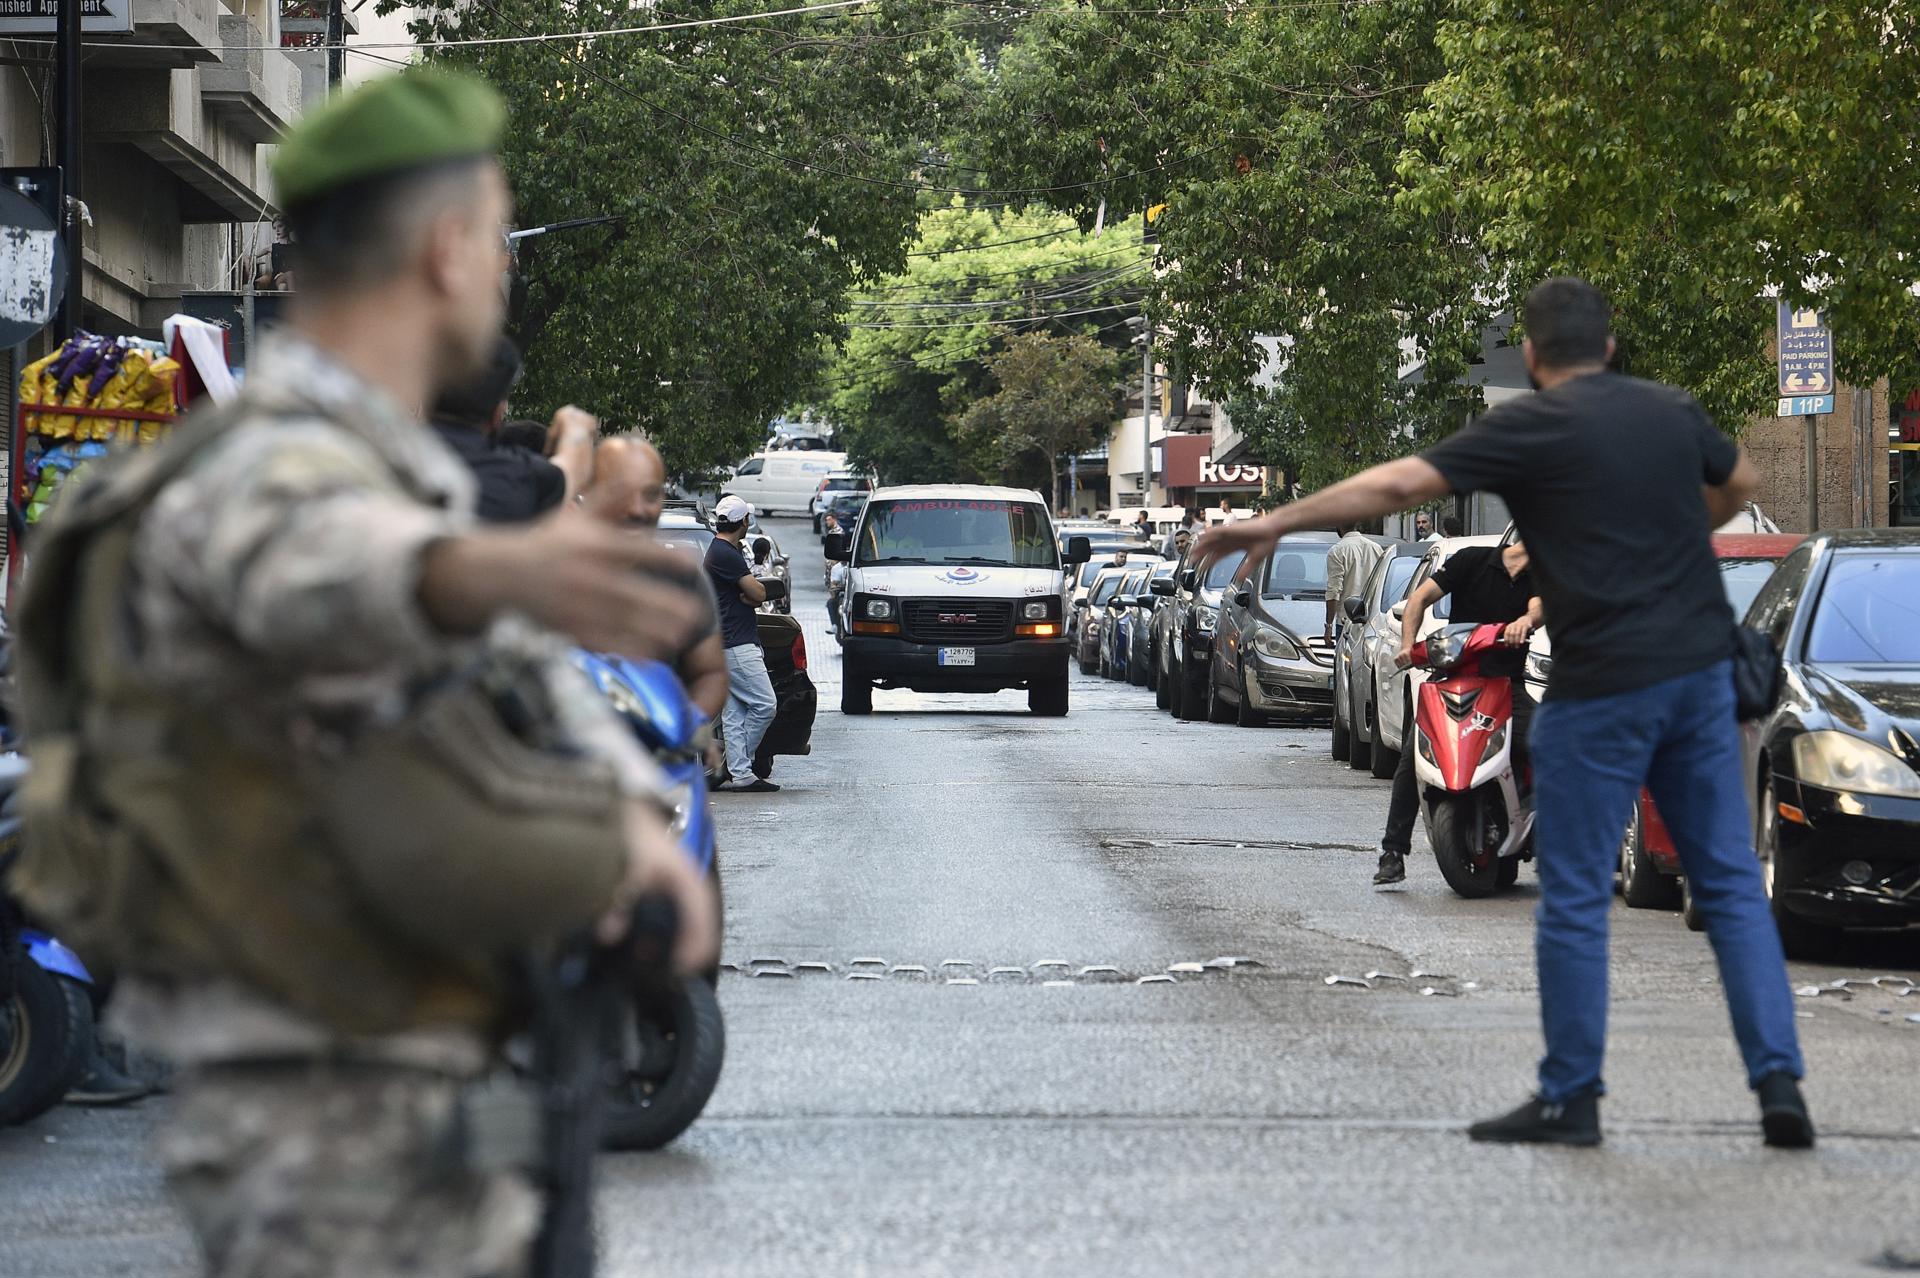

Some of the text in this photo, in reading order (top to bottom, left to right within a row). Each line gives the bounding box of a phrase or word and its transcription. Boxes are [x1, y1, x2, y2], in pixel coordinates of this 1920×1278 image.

[1799, 352, 1828, 360] PARKING
[1800, 398, 1824, 413] 11P
[891, 501, 1025, 515] AMBULANCE
[937, 613, 977, 624] GMC
